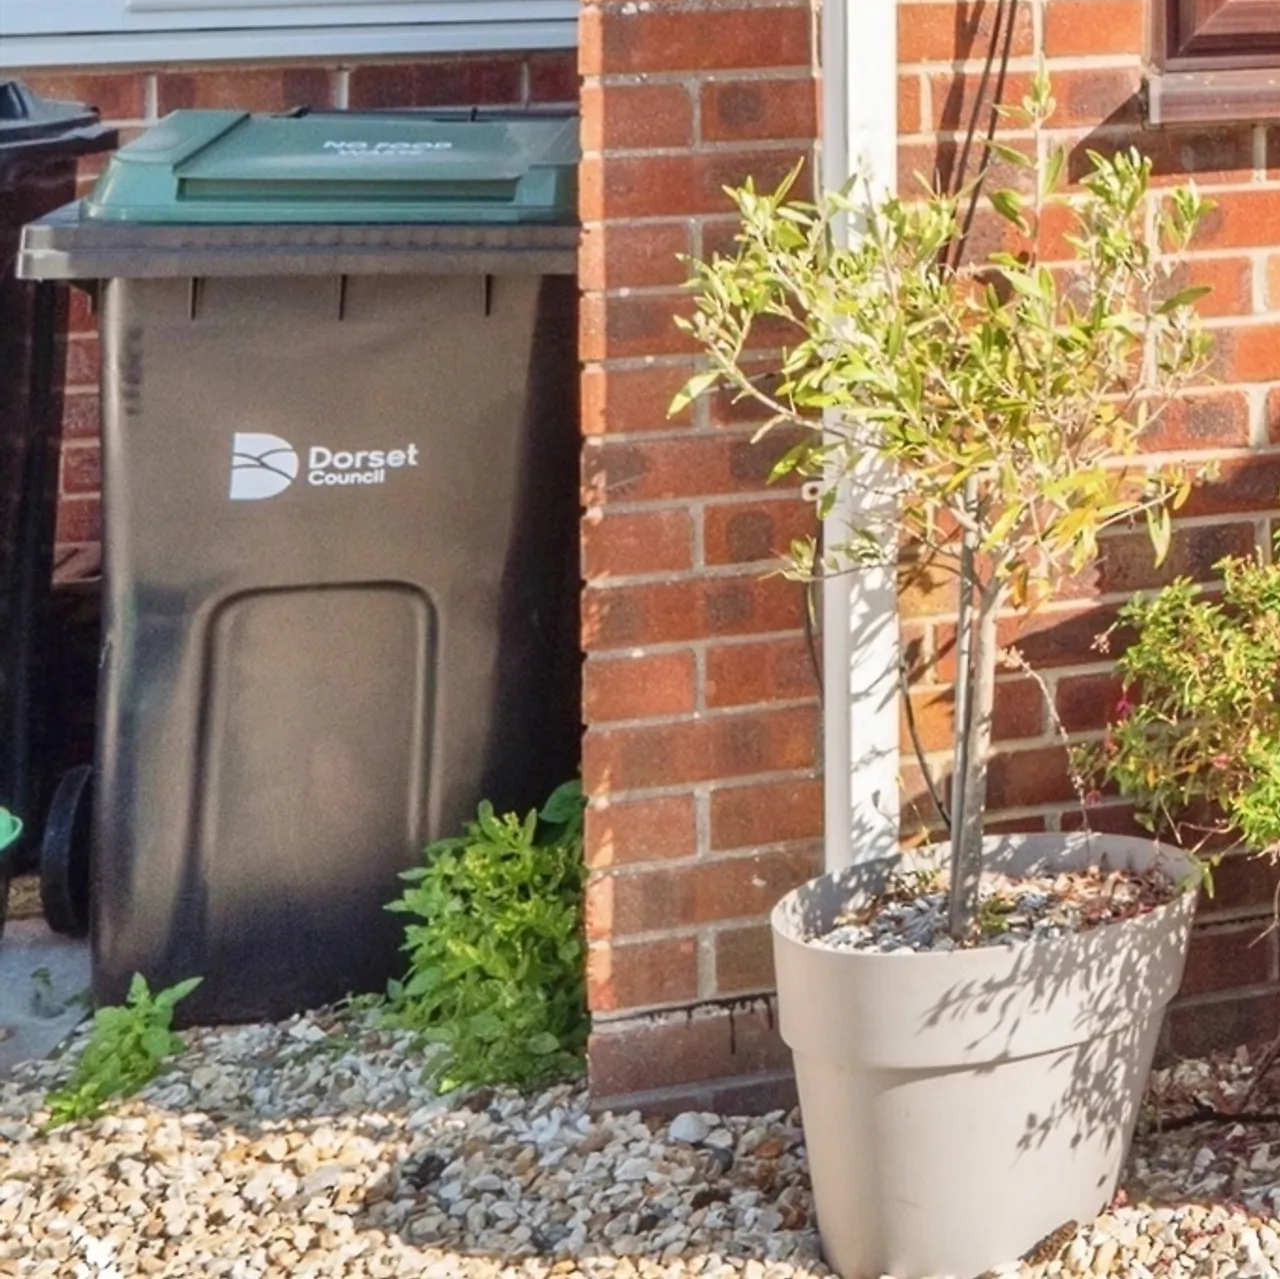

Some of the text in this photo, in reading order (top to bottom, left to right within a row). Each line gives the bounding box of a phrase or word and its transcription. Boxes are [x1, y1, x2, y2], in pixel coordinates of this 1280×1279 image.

[323, 140, 453, 150] NO FOOD
[308, 443, 418, 470] Dorset
[307, 469, 386, 486] Council
